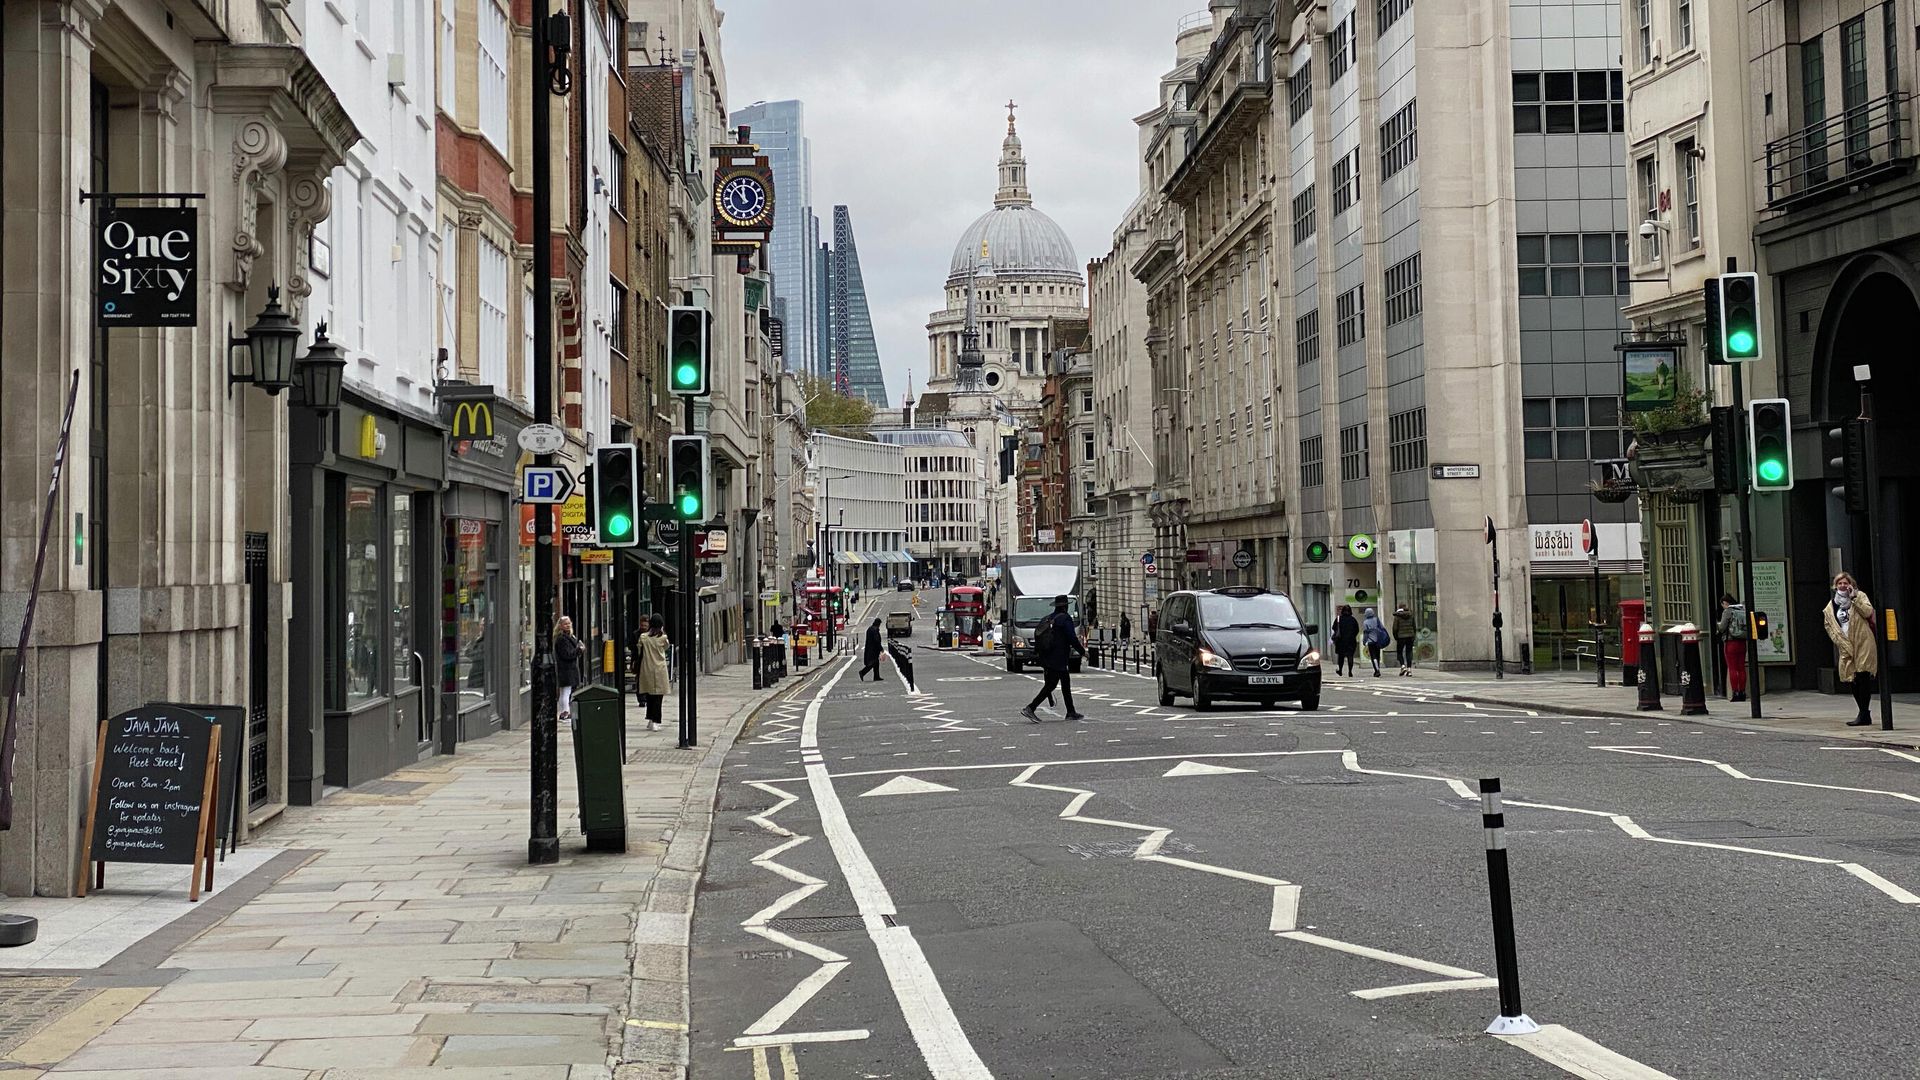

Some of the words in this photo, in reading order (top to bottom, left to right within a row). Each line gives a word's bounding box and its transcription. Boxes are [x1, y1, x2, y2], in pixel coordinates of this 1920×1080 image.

[104, 220, 190, 262] One
[102, 253, 192, 301] Sixty
[1611, 463, 1630, 480] M
[533, 475, 550, 496] P
[1535, 532, 1573, 549] wasabi
[1347, 579, 1360, 588] 70
[123, 717, 150, 733] JAVA
[153, 717, 180, 734] JAVA
[113, 742, 154, 755] Welcome
[128, 756, 149, 768] Fleet
[111, 777, 136, 790] Open
[109, 796, 135, 810] Follow
[120, 811, 129, 823] for
